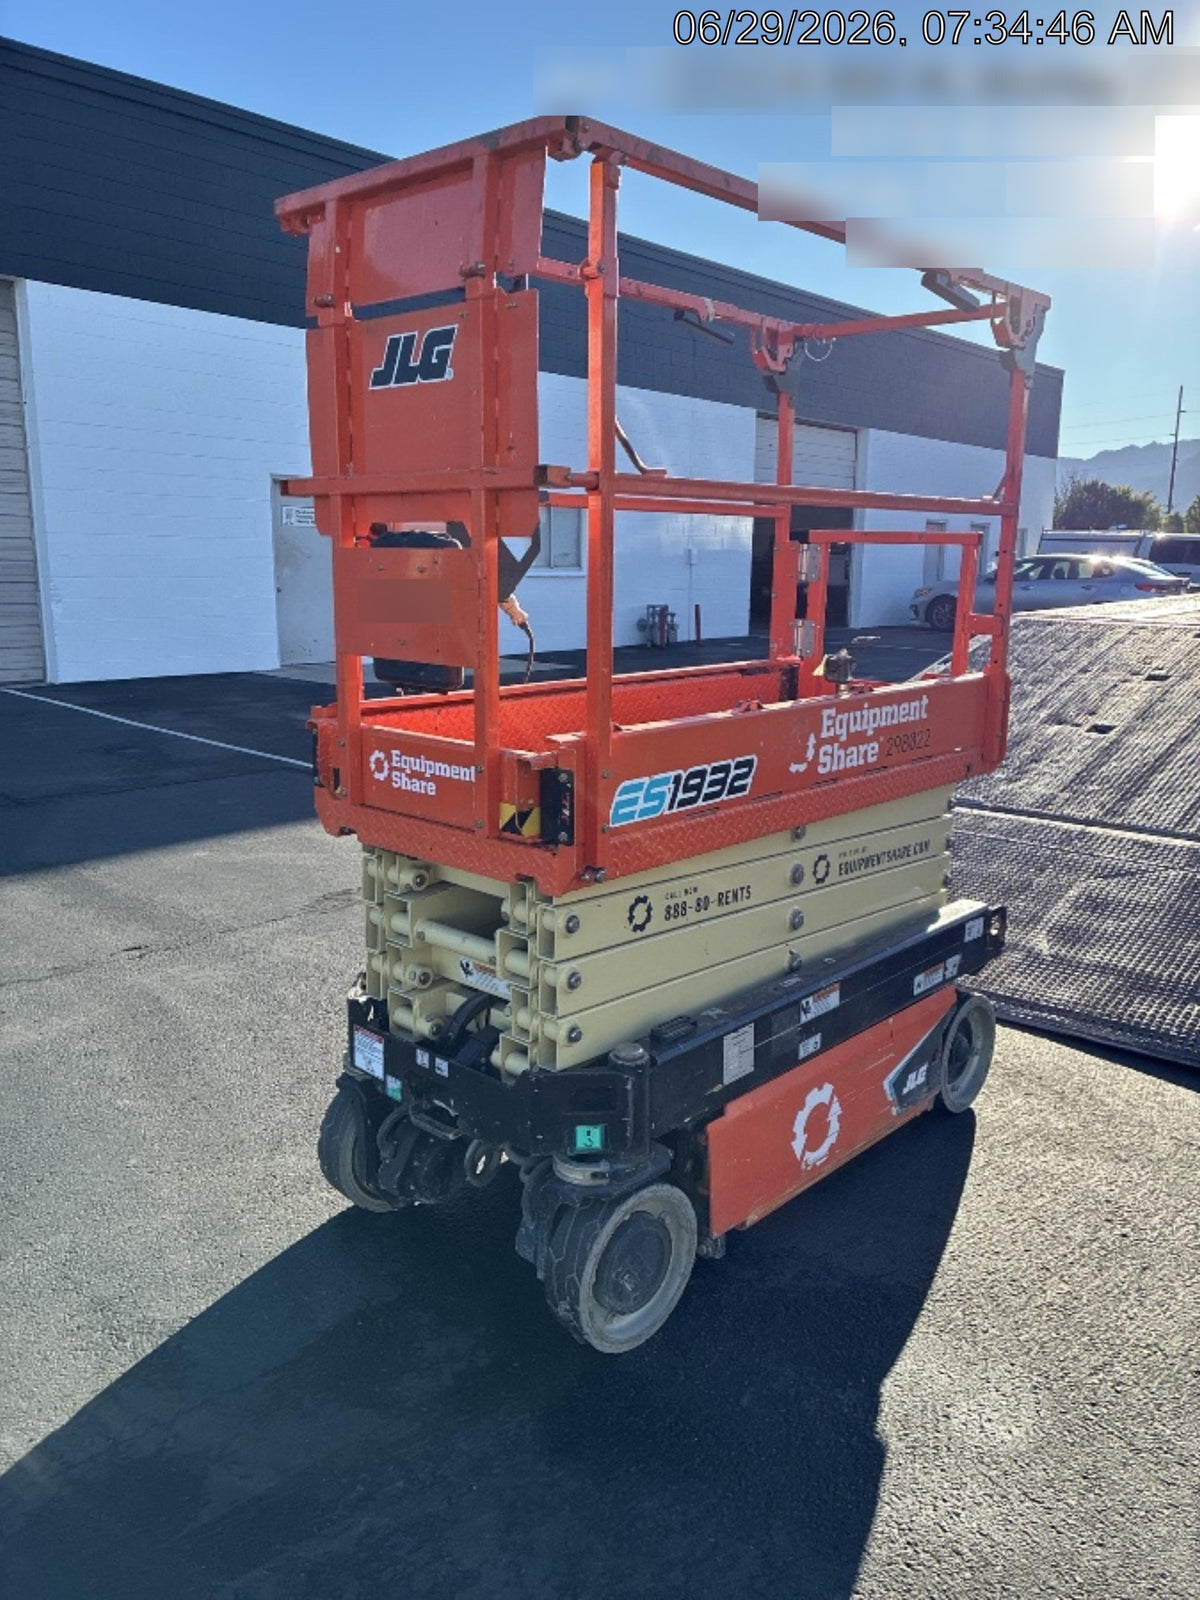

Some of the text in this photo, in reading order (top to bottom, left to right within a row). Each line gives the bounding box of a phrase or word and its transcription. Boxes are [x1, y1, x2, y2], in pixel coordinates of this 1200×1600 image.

[369, 324, 458, 390] JLG
[820, 694, 929, 742] Equipment
[391, 749, 475, 783] Equipment
[818, 741, 879, 774] Share
[392, 770, 436, 796] Share
[610, 755, 757, 826] ES1932
